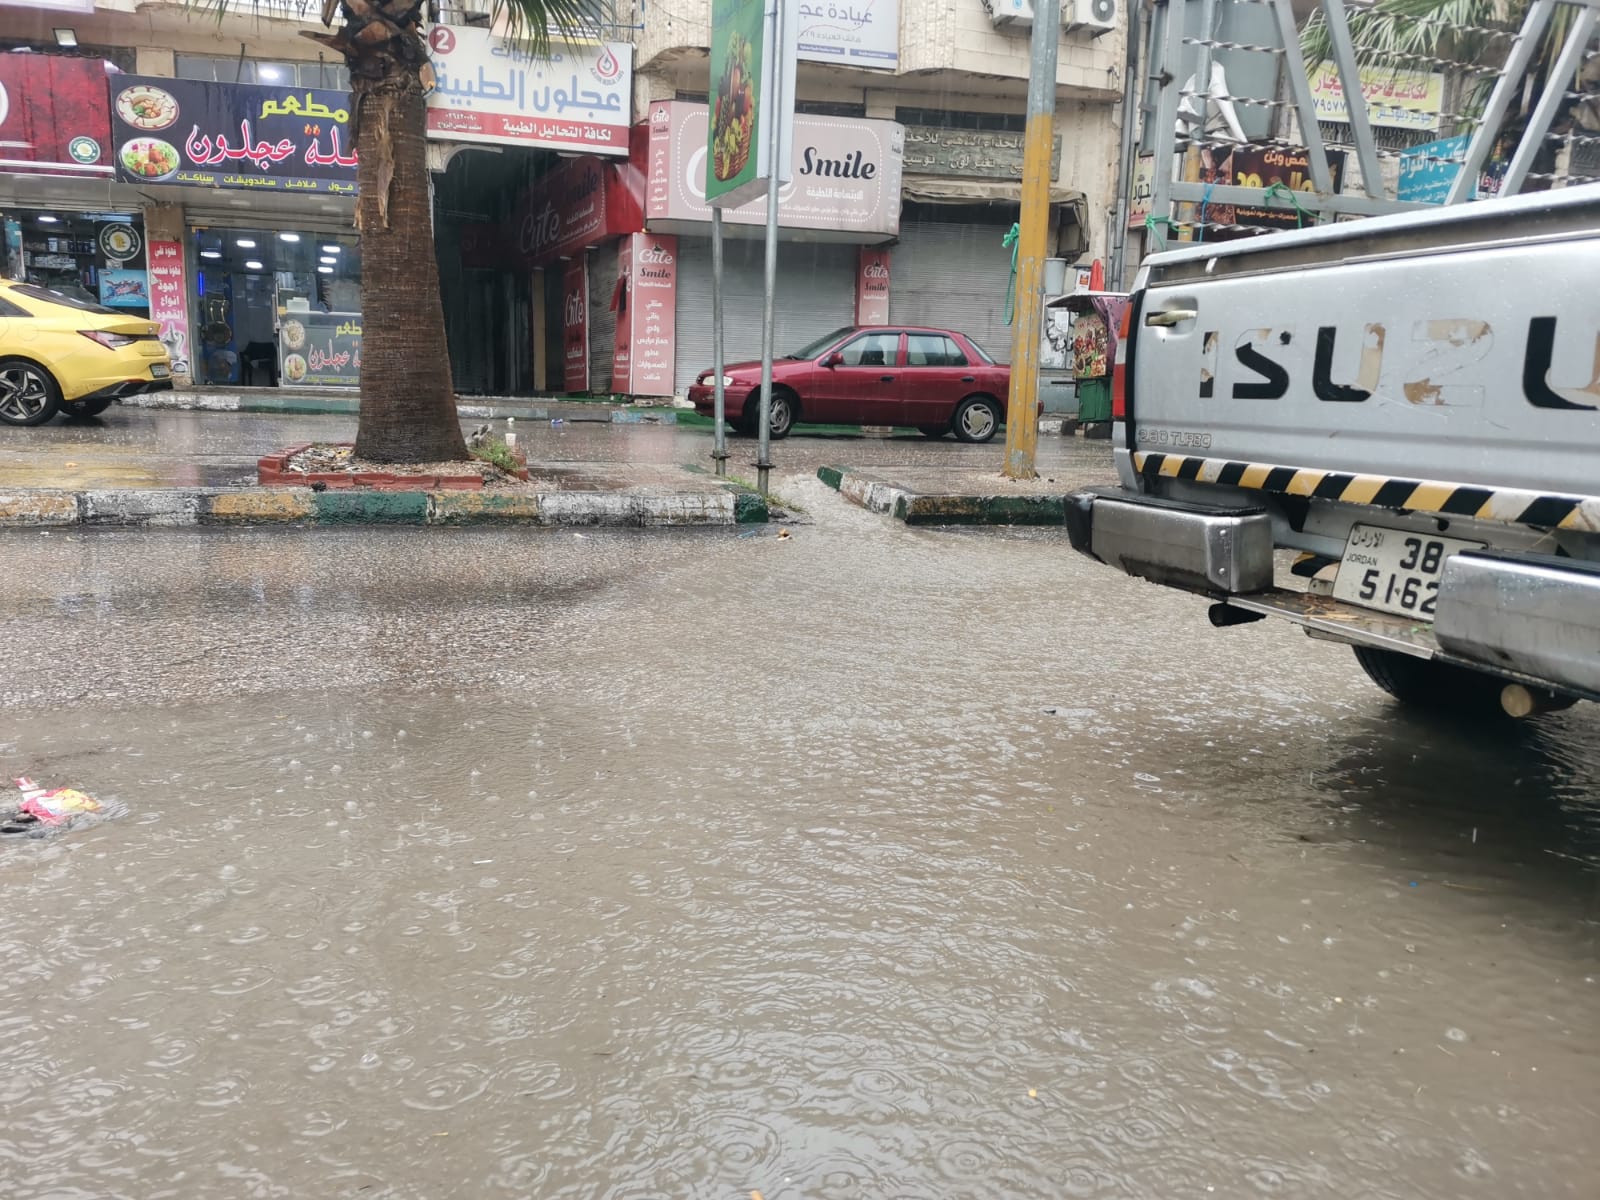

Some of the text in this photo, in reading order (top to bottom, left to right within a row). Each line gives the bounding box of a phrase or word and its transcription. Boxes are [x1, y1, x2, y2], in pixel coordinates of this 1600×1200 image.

[828, 3, 872, 25] عيادة
[435, 29, 449, 50] 2
[435, 62, 621, 119] عجلون الطبية
[259, 92, 349, 123] مطعم
[503, 118, 611, 141] لكافة التحاليل الطبية
[185, 118, 296, 170] عجلون
[799, 146, 876, 180] Smile
[176, 172, 353, 191] فول فلافل ساندويشات سناكات
[639, 248, 673, 265] Cute
[640, 267, 671, 279] Smile
[336, 320, 362, 338] طعم
[1170, 431, 1211, 448] TURBO
[1346, 553, 1378, 567] JORDAN
[1400, 537, 1444, 574] 38
[1359, 569, 1440, 614] 5162
